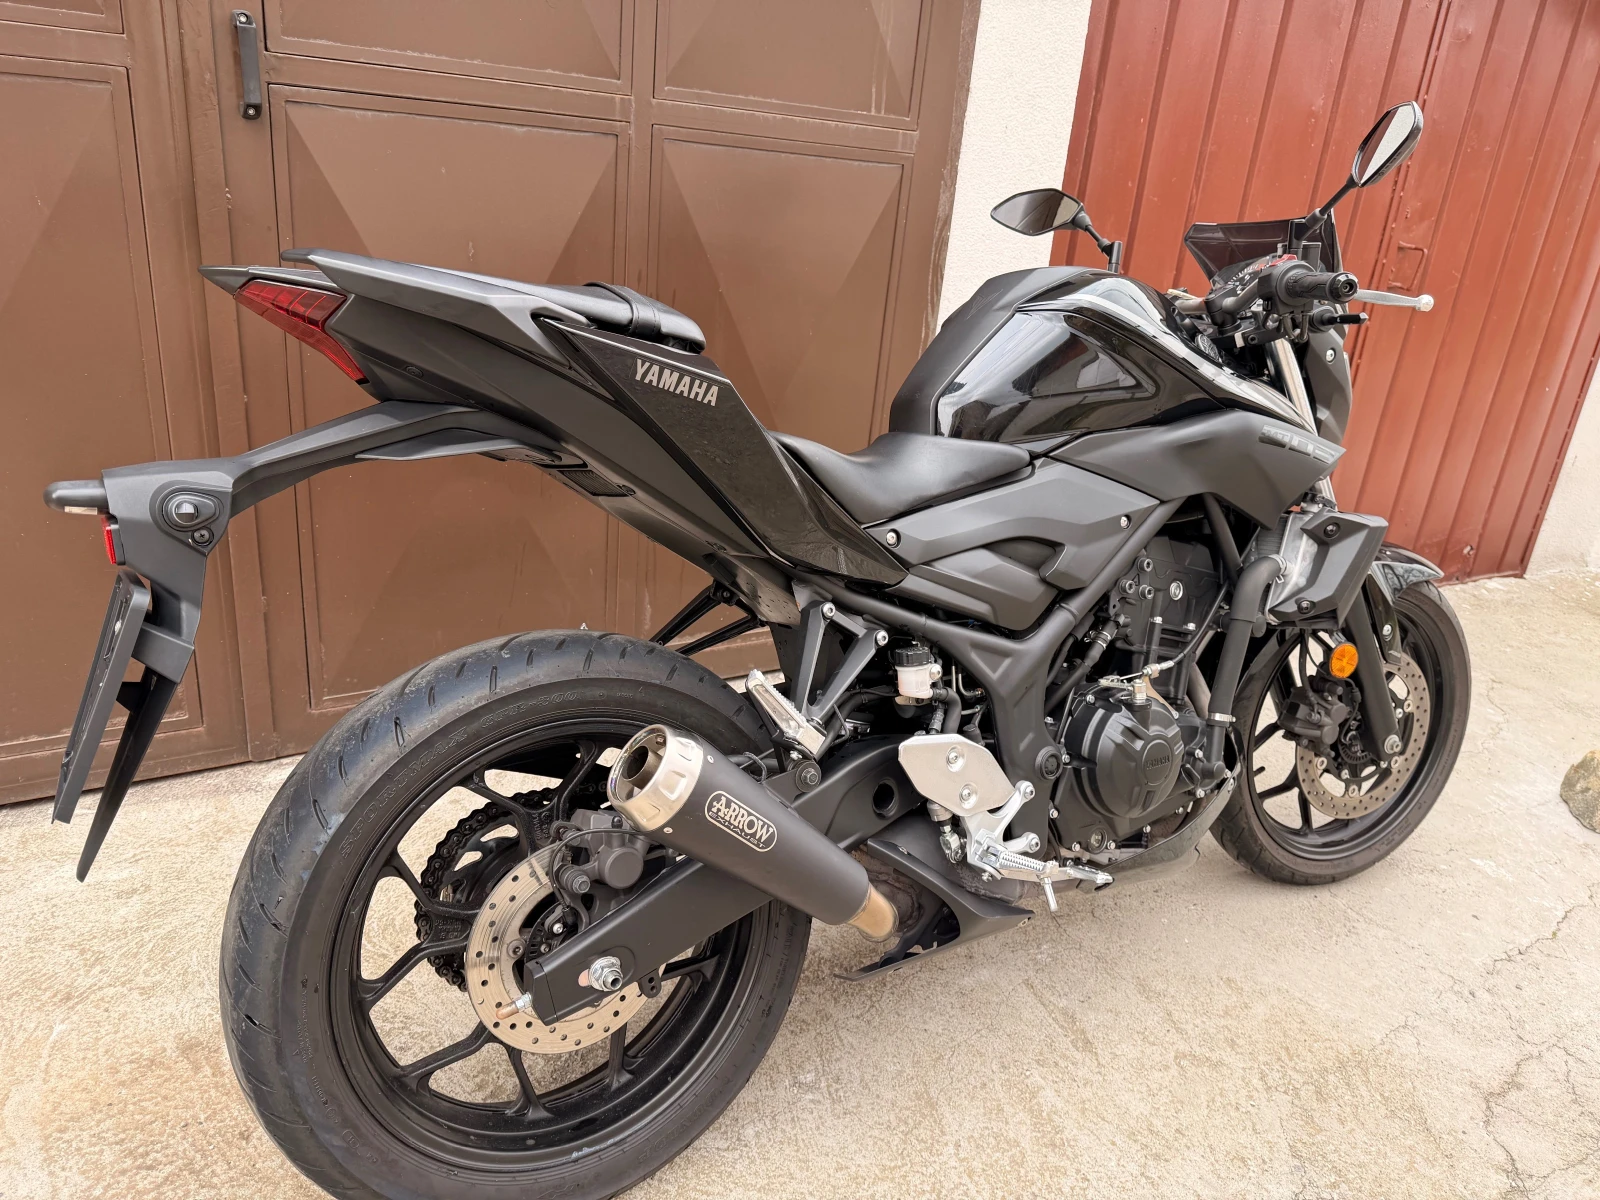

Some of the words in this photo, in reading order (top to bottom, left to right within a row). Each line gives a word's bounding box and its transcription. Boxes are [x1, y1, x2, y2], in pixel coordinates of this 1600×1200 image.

[635, 358, 719, 407] YAMAHA
[338, 726, 469, 860] SPORTMAX
[711, 796, 774, 842] ARROW
